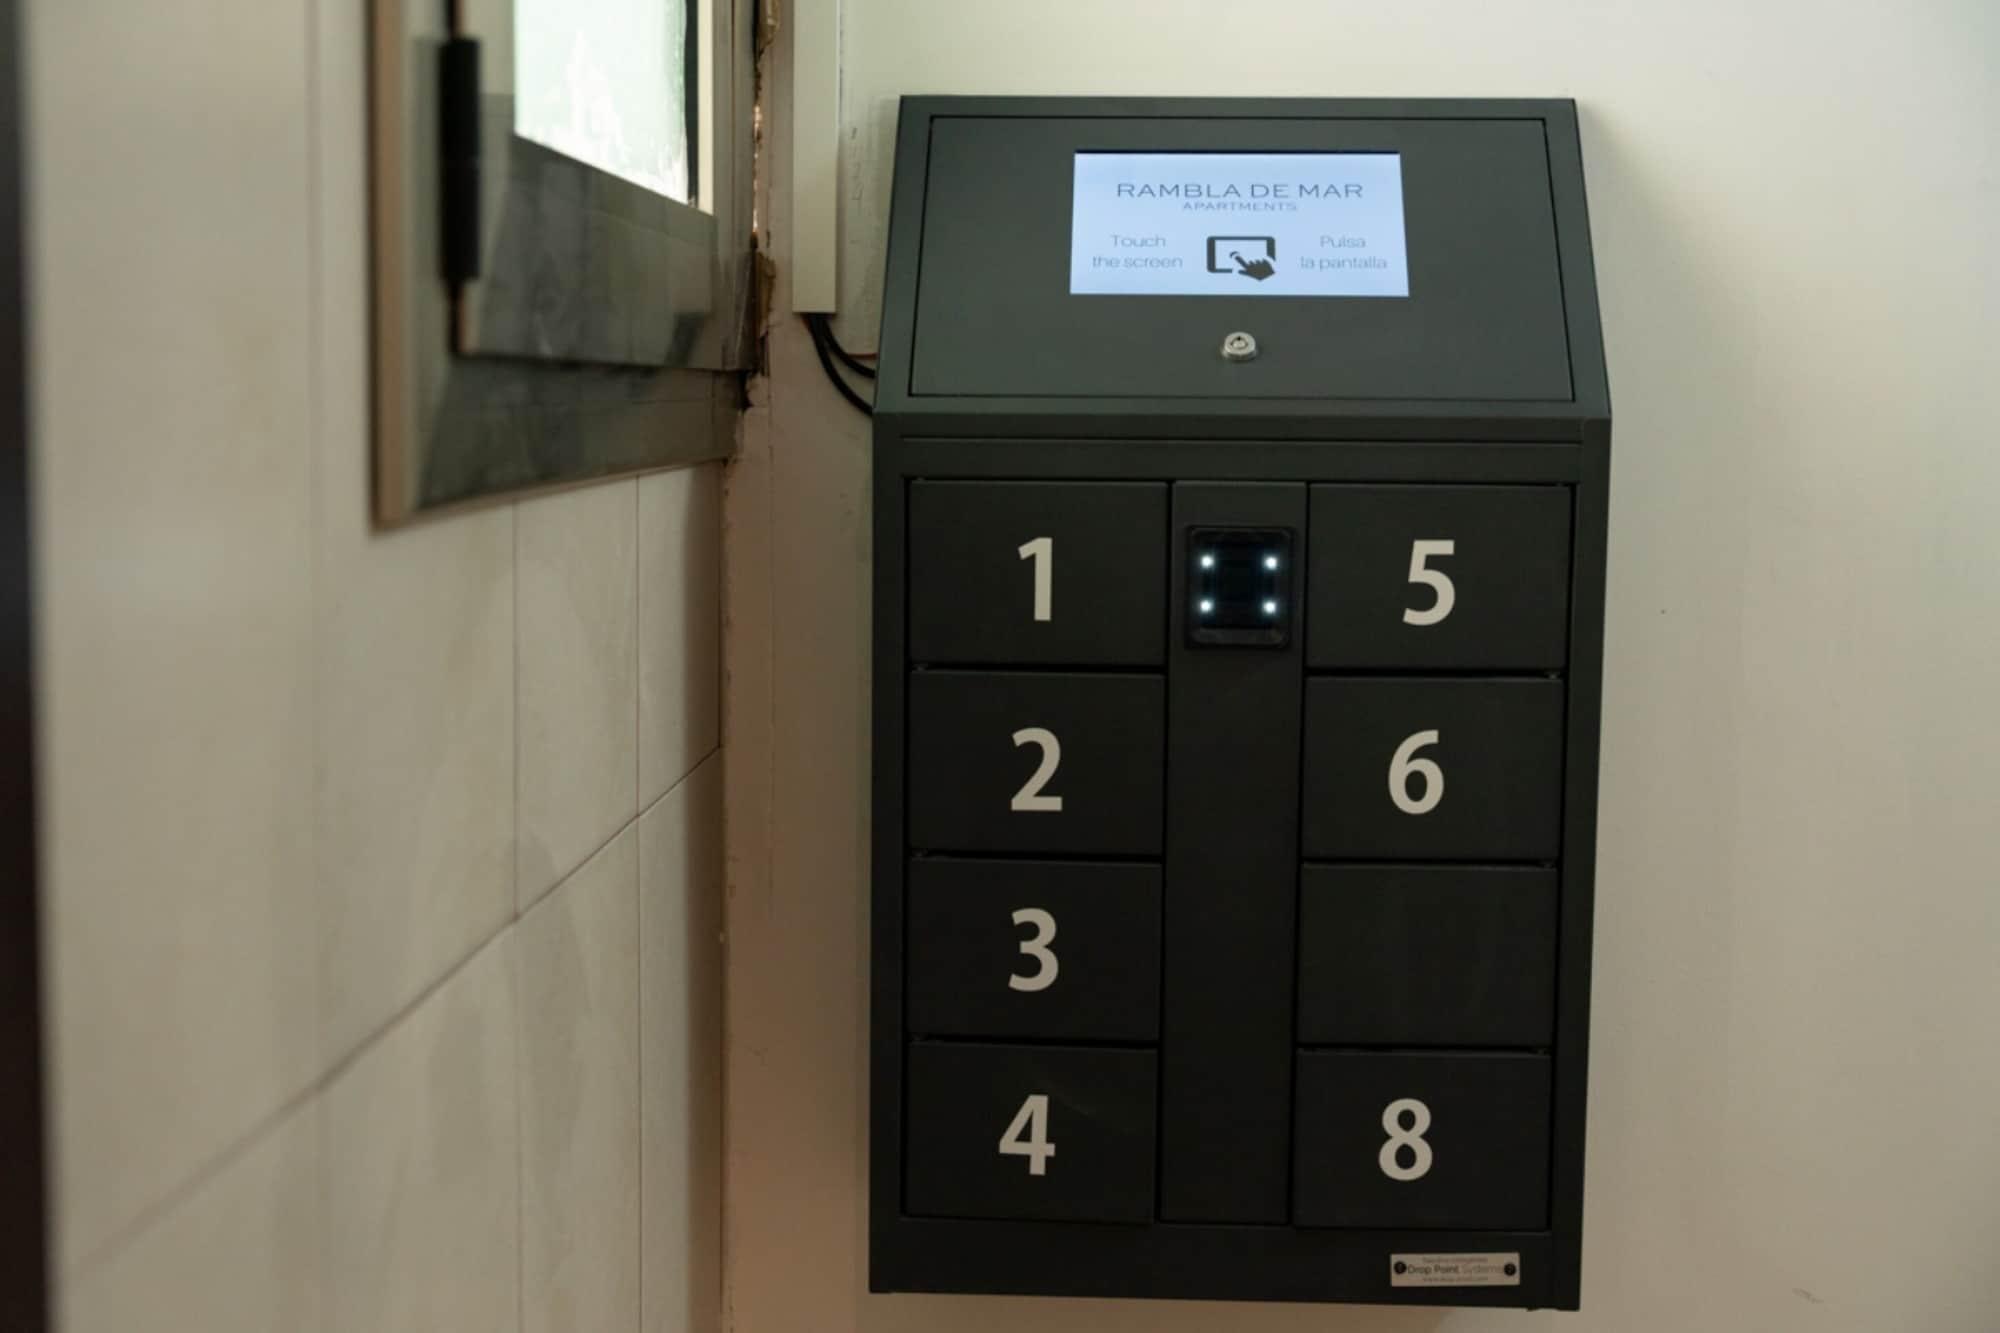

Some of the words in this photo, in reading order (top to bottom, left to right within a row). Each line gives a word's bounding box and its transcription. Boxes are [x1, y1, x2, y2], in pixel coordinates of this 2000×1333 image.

[1116, 183, 1242, 199] RAMBLA
[1250, 183, 1290, 199] DE
[1297, 183, 1365, 199] MAR
[1182, 201, 1298, 212] APARTMENTS
[1092, 254, 1120, 269] the
[1122, 257, 1184, 269] screen
[1110, 234, 1167, 249] Touch
[1300, 255, 1315, 269] la
[1318, 255, 1389, 272] pantalla
[1319, 235, 1367, 249] Pulsa
[1018, 537, 1053, 622] 1
[1402, 539, 1456, 626] 5
[1010, 728, 1063, 812] 2
[1387, 730, 1444, 815] 6
[1008, 908, 1059, 992] 3
[998, 1095, 1056, 1176] 4
[1378, 1098, 1434, 1182] 8
[1407, 1264, 1433, 1275] Drop
